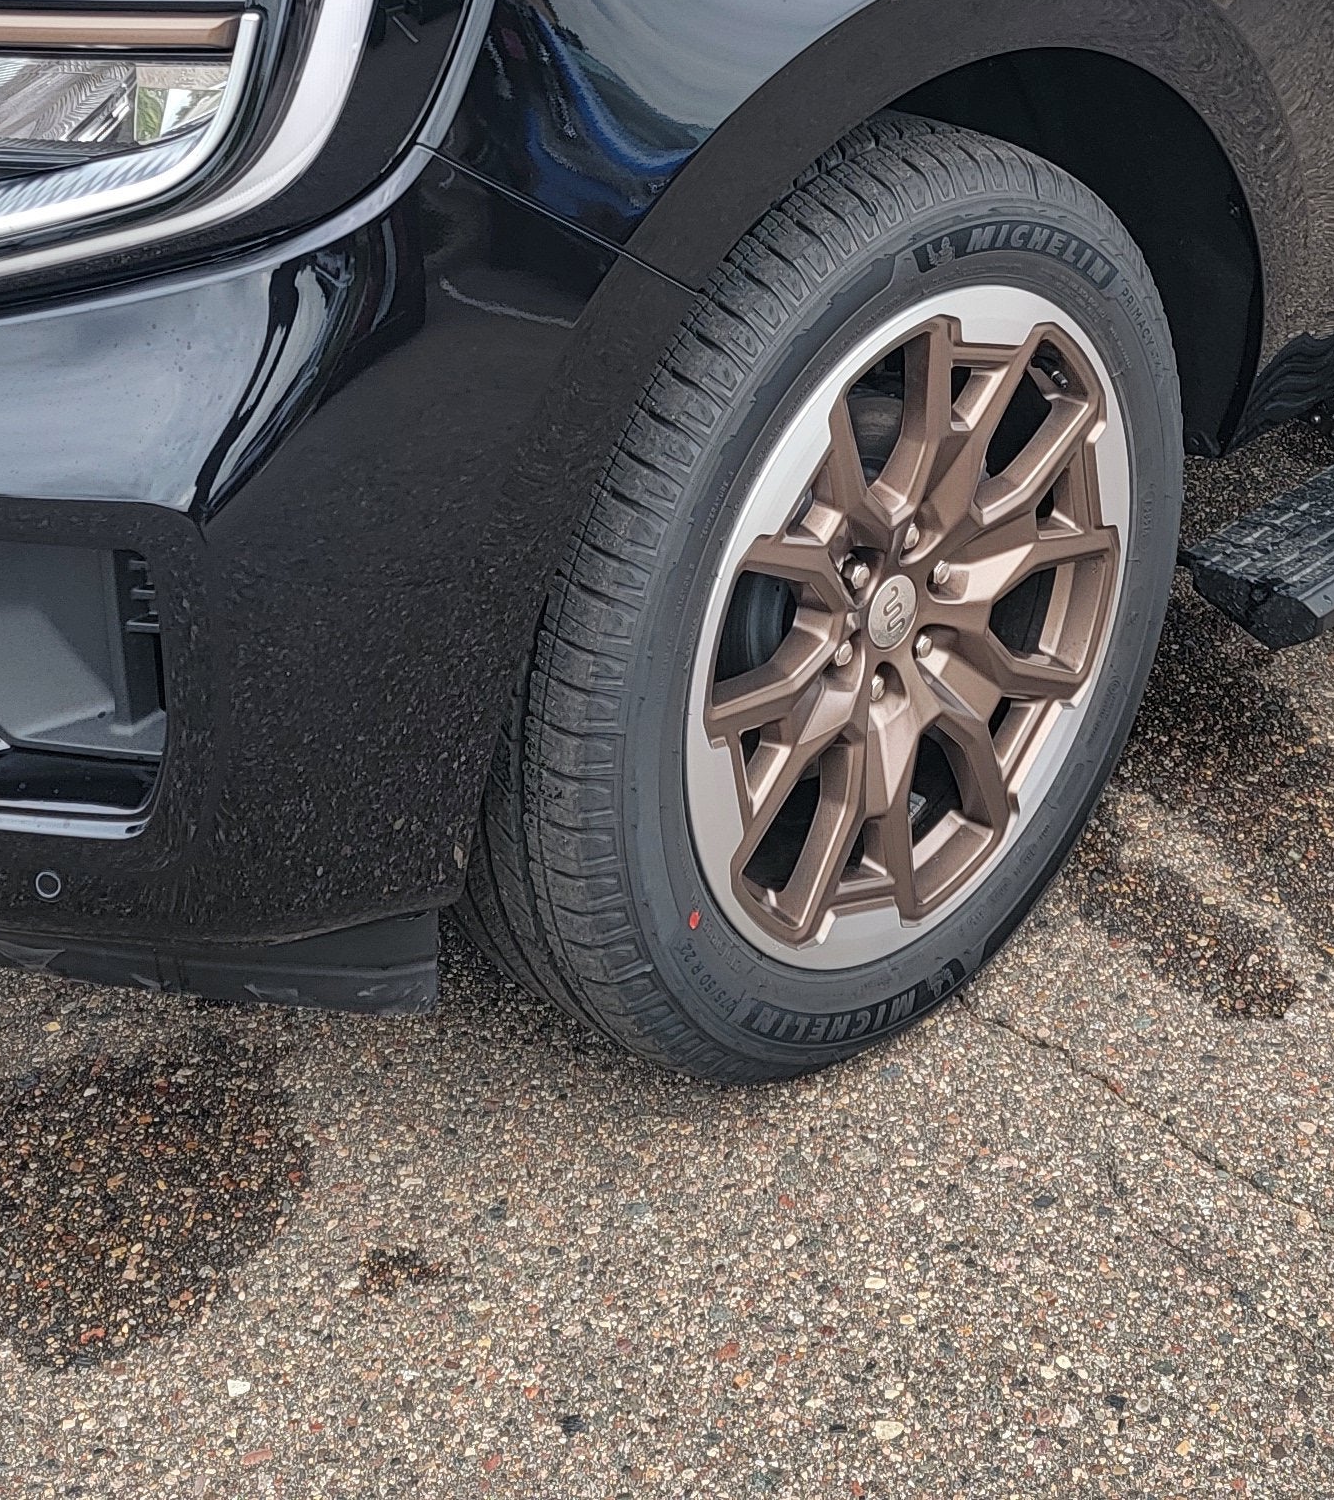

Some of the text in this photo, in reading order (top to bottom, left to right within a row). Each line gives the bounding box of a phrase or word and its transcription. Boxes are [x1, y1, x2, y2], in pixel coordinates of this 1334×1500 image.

[966, 225, 1110, 284] MICHELIN
[1121, 287, 1155, 346] PRIMACY
[752, 989, 916, 1041] MICHELIN
